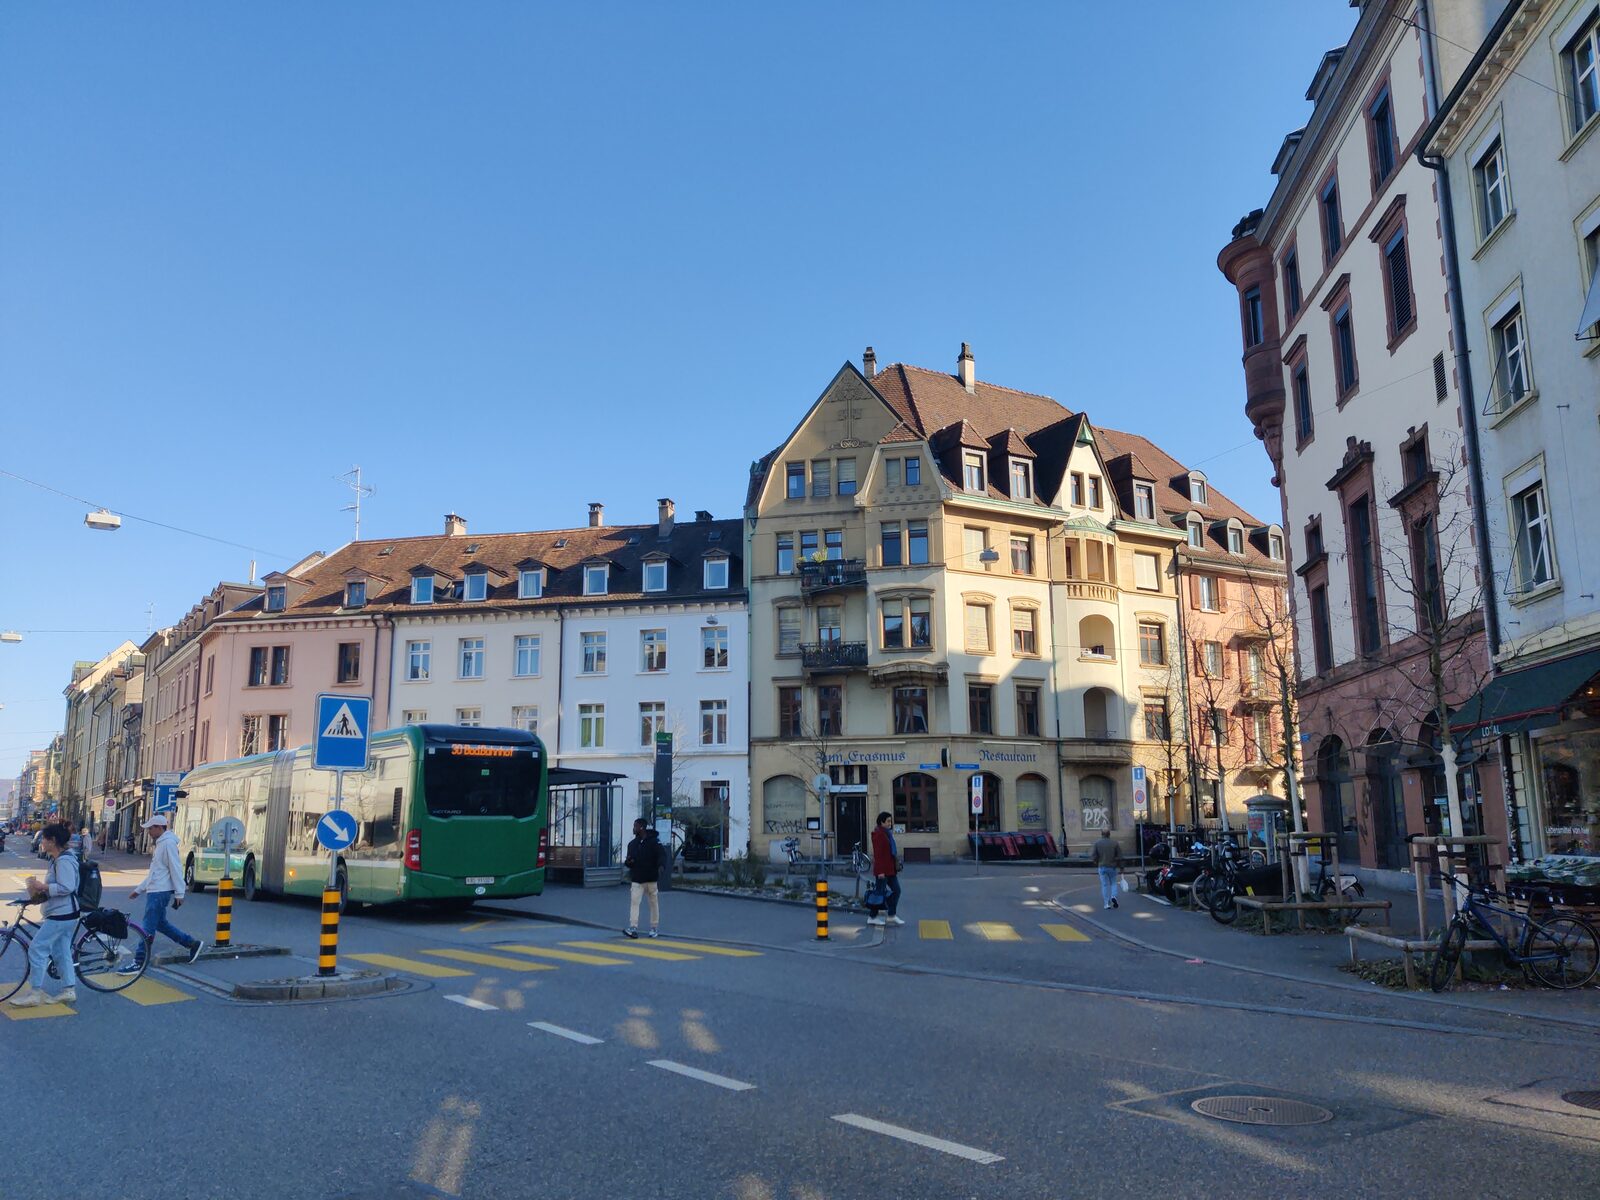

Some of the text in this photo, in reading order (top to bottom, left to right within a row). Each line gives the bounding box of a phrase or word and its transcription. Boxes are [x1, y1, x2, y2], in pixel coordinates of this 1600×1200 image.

[1481, 724, 1501, 737] LOAL
[848, 751, 906, 762] Erasmus
[979, 750, 1037, 762] Restaurant
